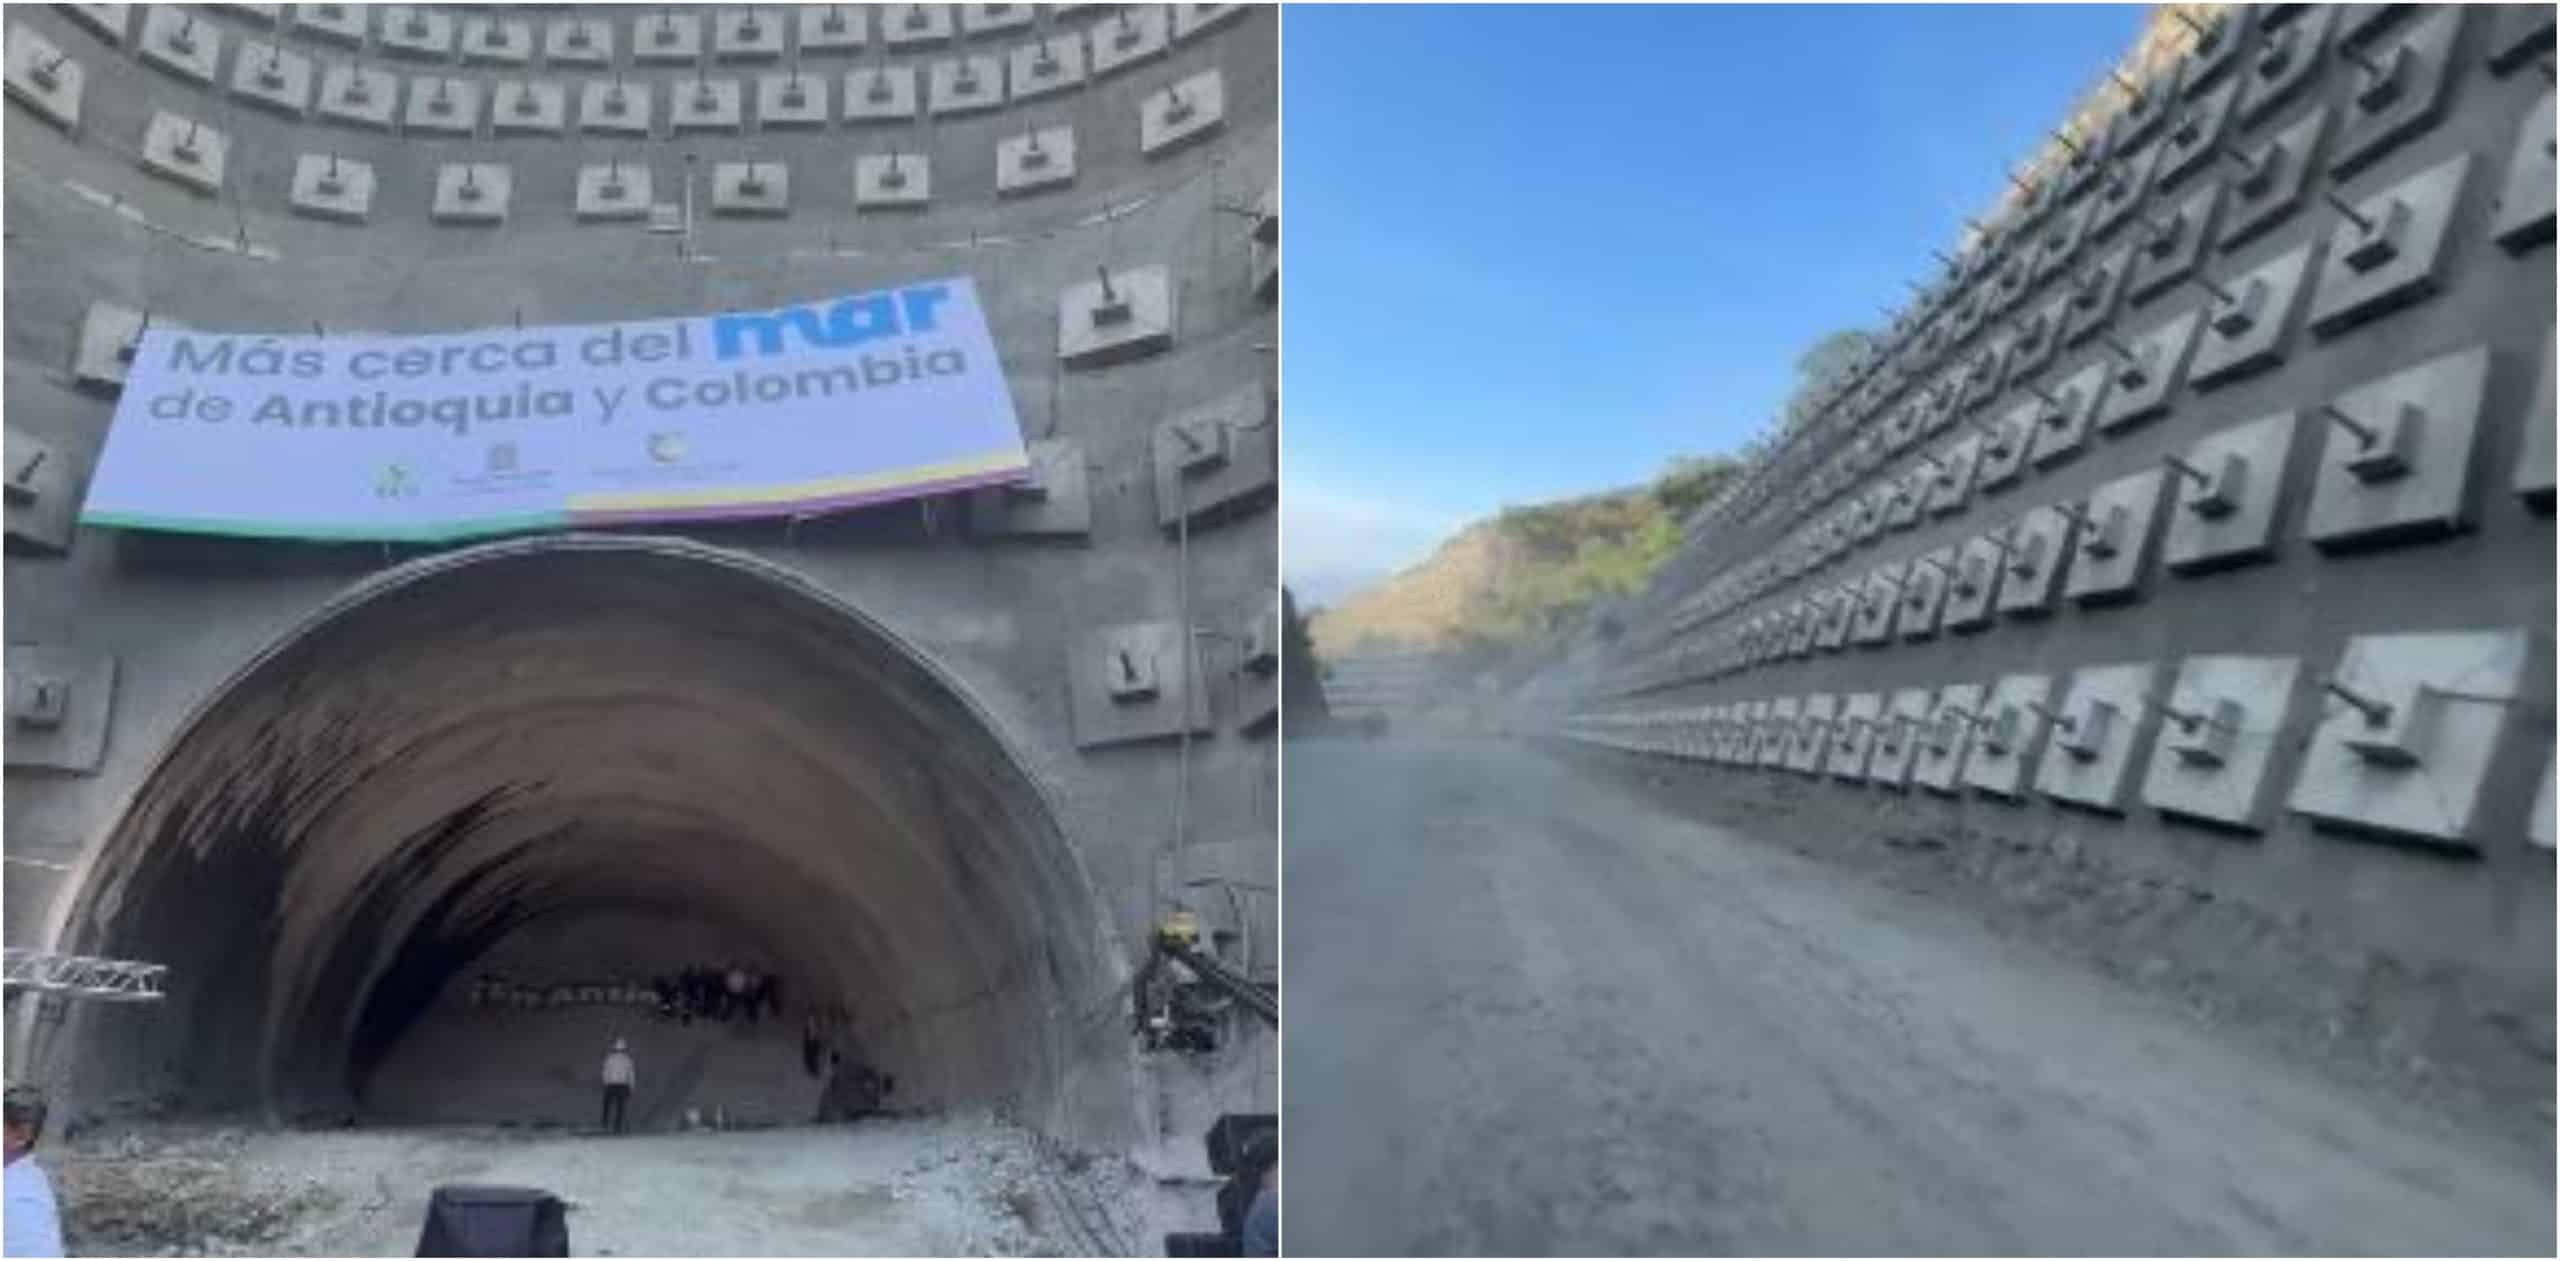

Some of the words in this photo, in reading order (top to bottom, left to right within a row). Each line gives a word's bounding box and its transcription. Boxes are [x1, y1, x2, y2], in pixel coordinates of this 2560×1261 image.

[169, 336, 326, 379] Más
[347, 339, 559, 380] cerca
[579, 325, 693, 366] del
[713, 286, 950, 361] mar
[148, 390, 233, 423] de
[251, 383, 574, 435] Antioquia
[594, 386, 626, 424] y
[644, 345, 966, 411] Colombia
